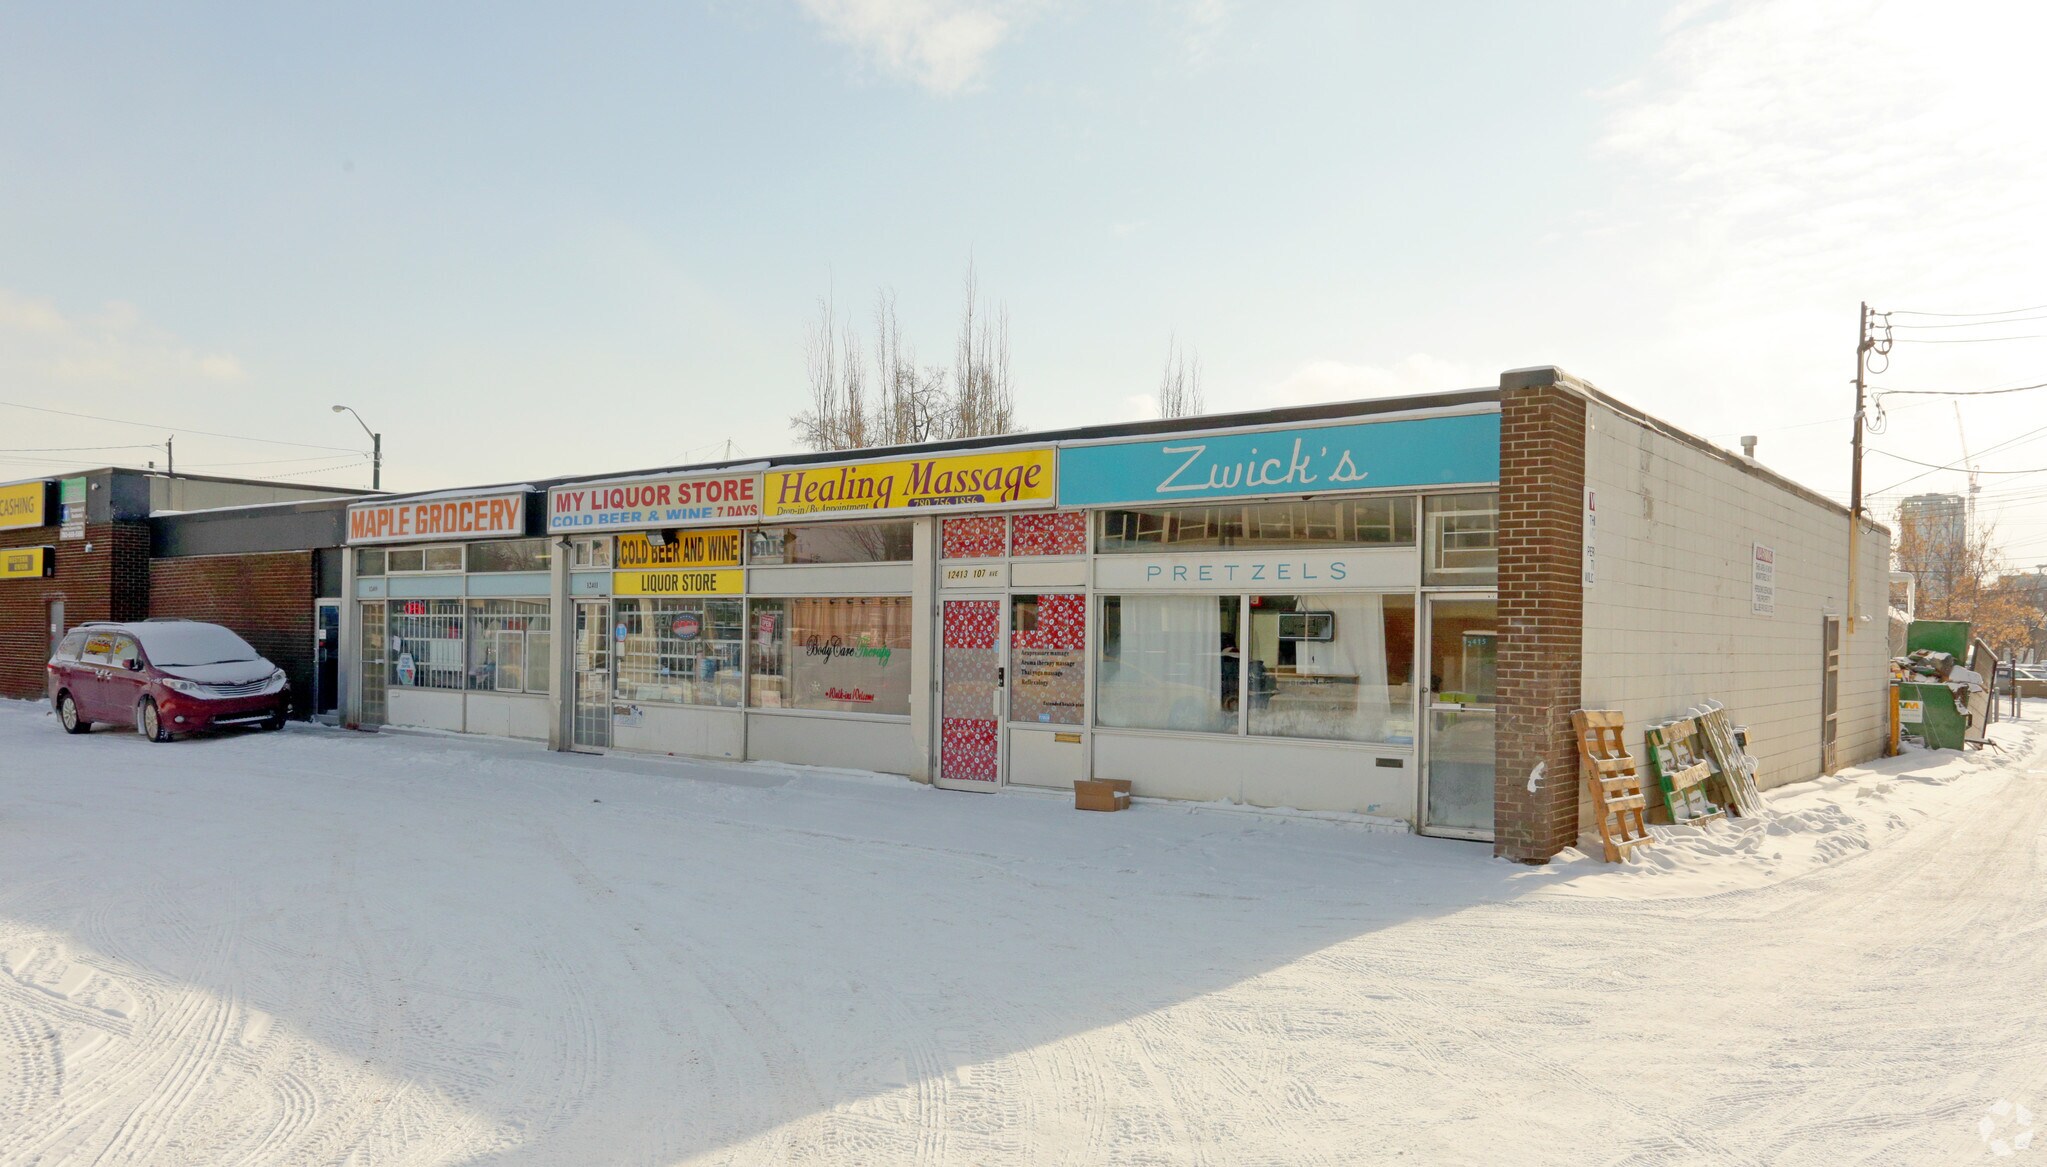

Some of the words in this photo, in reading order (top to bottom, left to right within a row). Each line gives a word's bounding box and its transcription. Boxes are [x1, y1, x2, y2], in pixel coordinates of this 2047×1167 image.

[1156, 438, 1369, 492] Zwick's
[556, 491, 584, 513] MY
[591, 484, 671, 510] LIQUOR
[677, 478, 754, 504] STORE
[777, 467, 894, 509] Healing
[902, 461, 1041, 502] Massage
[351, 506, 410, 539] MAPLE
[415, 497, 520, 534] GROCERY
[552, 514, 593, 528] COLD
[598, 511, 642, 524] BEER
[647, 510, 660, 522] &
[666, 506, 712, 519] WINE
[716, 506, 724, 517] 7
[727, 504, 758, 517] DAYS
[621, 537, 648, 564] COLD
[651, 541, 680, 563] BEER
[683, 535, 704, 562] AND
[708, 535, 738, 560] WINE
[641, 575, 678, 592] LIQUOR
[682, 573, 717, 591] STORE
[948, 570, 968, 579] 12413
[973, 569, 986, 578] 107
[1147, 561, 1347, 582] PRETZELS
[404, 600, 425, 615] OPEN
